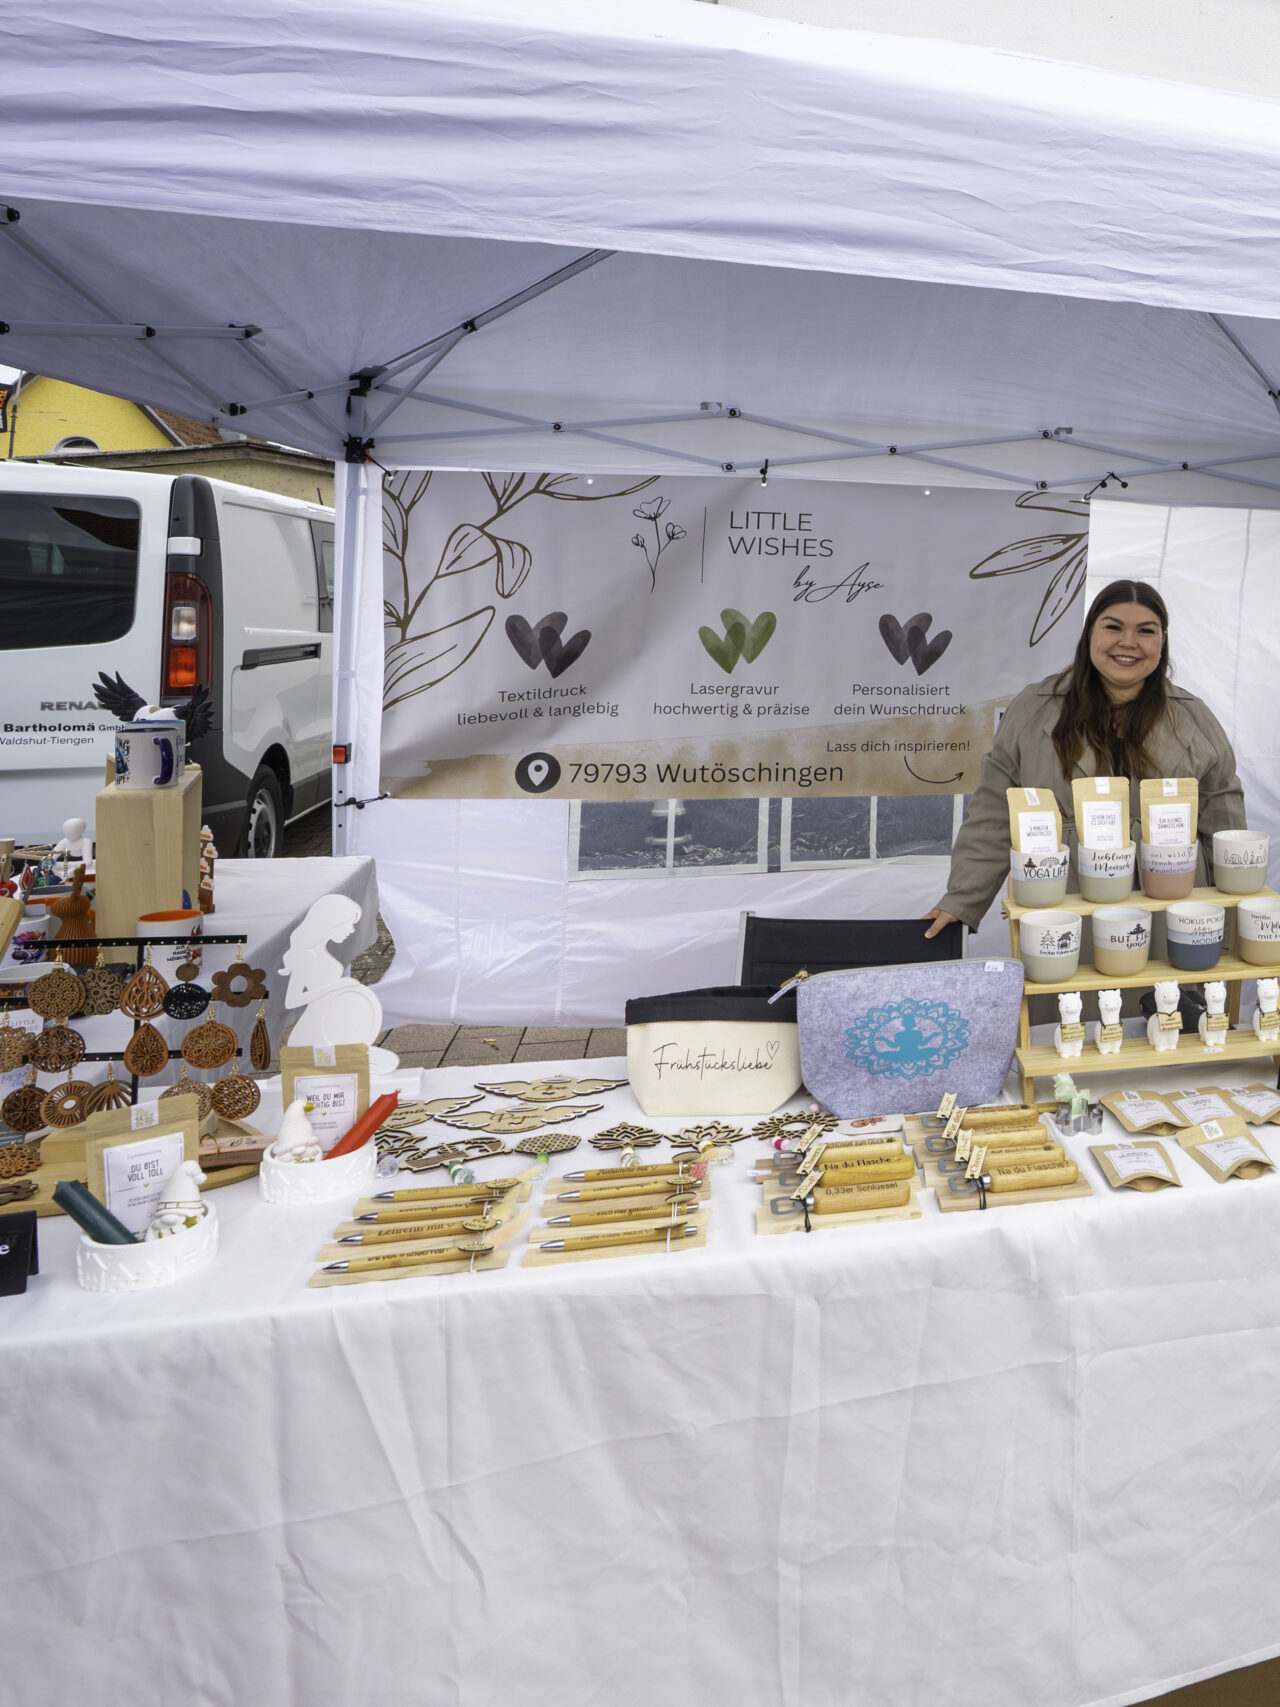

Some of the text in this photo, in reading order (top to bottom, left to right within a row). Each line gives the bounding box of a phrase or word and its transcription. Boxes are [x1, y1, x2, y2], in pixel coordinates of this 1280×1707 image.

[730, 511, 813, 532] LITTLE
[728, 536, 834, 557] WISHES
[793, 565, 817, 602] by
[498, 684, 587, 703] Textildruck
[690, 683, 780, 698] Lasergravur
[852, 683, 951, 697] Personalisiert
[40, 701, 105, 711] RENA
[653, 703, 810, 719] hochwertig & präzise
[834, 704, 967, 716] dein Wunschdruck
[457, 701, 619, 726] liebevoll & langlebig
[3, 722, 95, 732] Bartholomä
[827, 740, 971, 755] Lass dich inspirieren!
[569, 762, 844, 787] 79793 Wutöschingen
[1023, 867, 1050, 879] YOGA
[1178, 917, 1205, 925] HOKUS
[1110, 935, 1131, 944] BUT
[653, 1043, 773, 1080] Frühstücksliebe
[313, 1101, 330, 1109] CHTIG
[130, 1159, 160, 1173] DU BIST
[856, 1157, 892, 1167] Flasche
[997, 1160, 1070, 1176] Na du Flasche?
[127, 1168, 164, 1182] VOLL TOLL
[856, 1181, 898, 1192] Schlüssel
